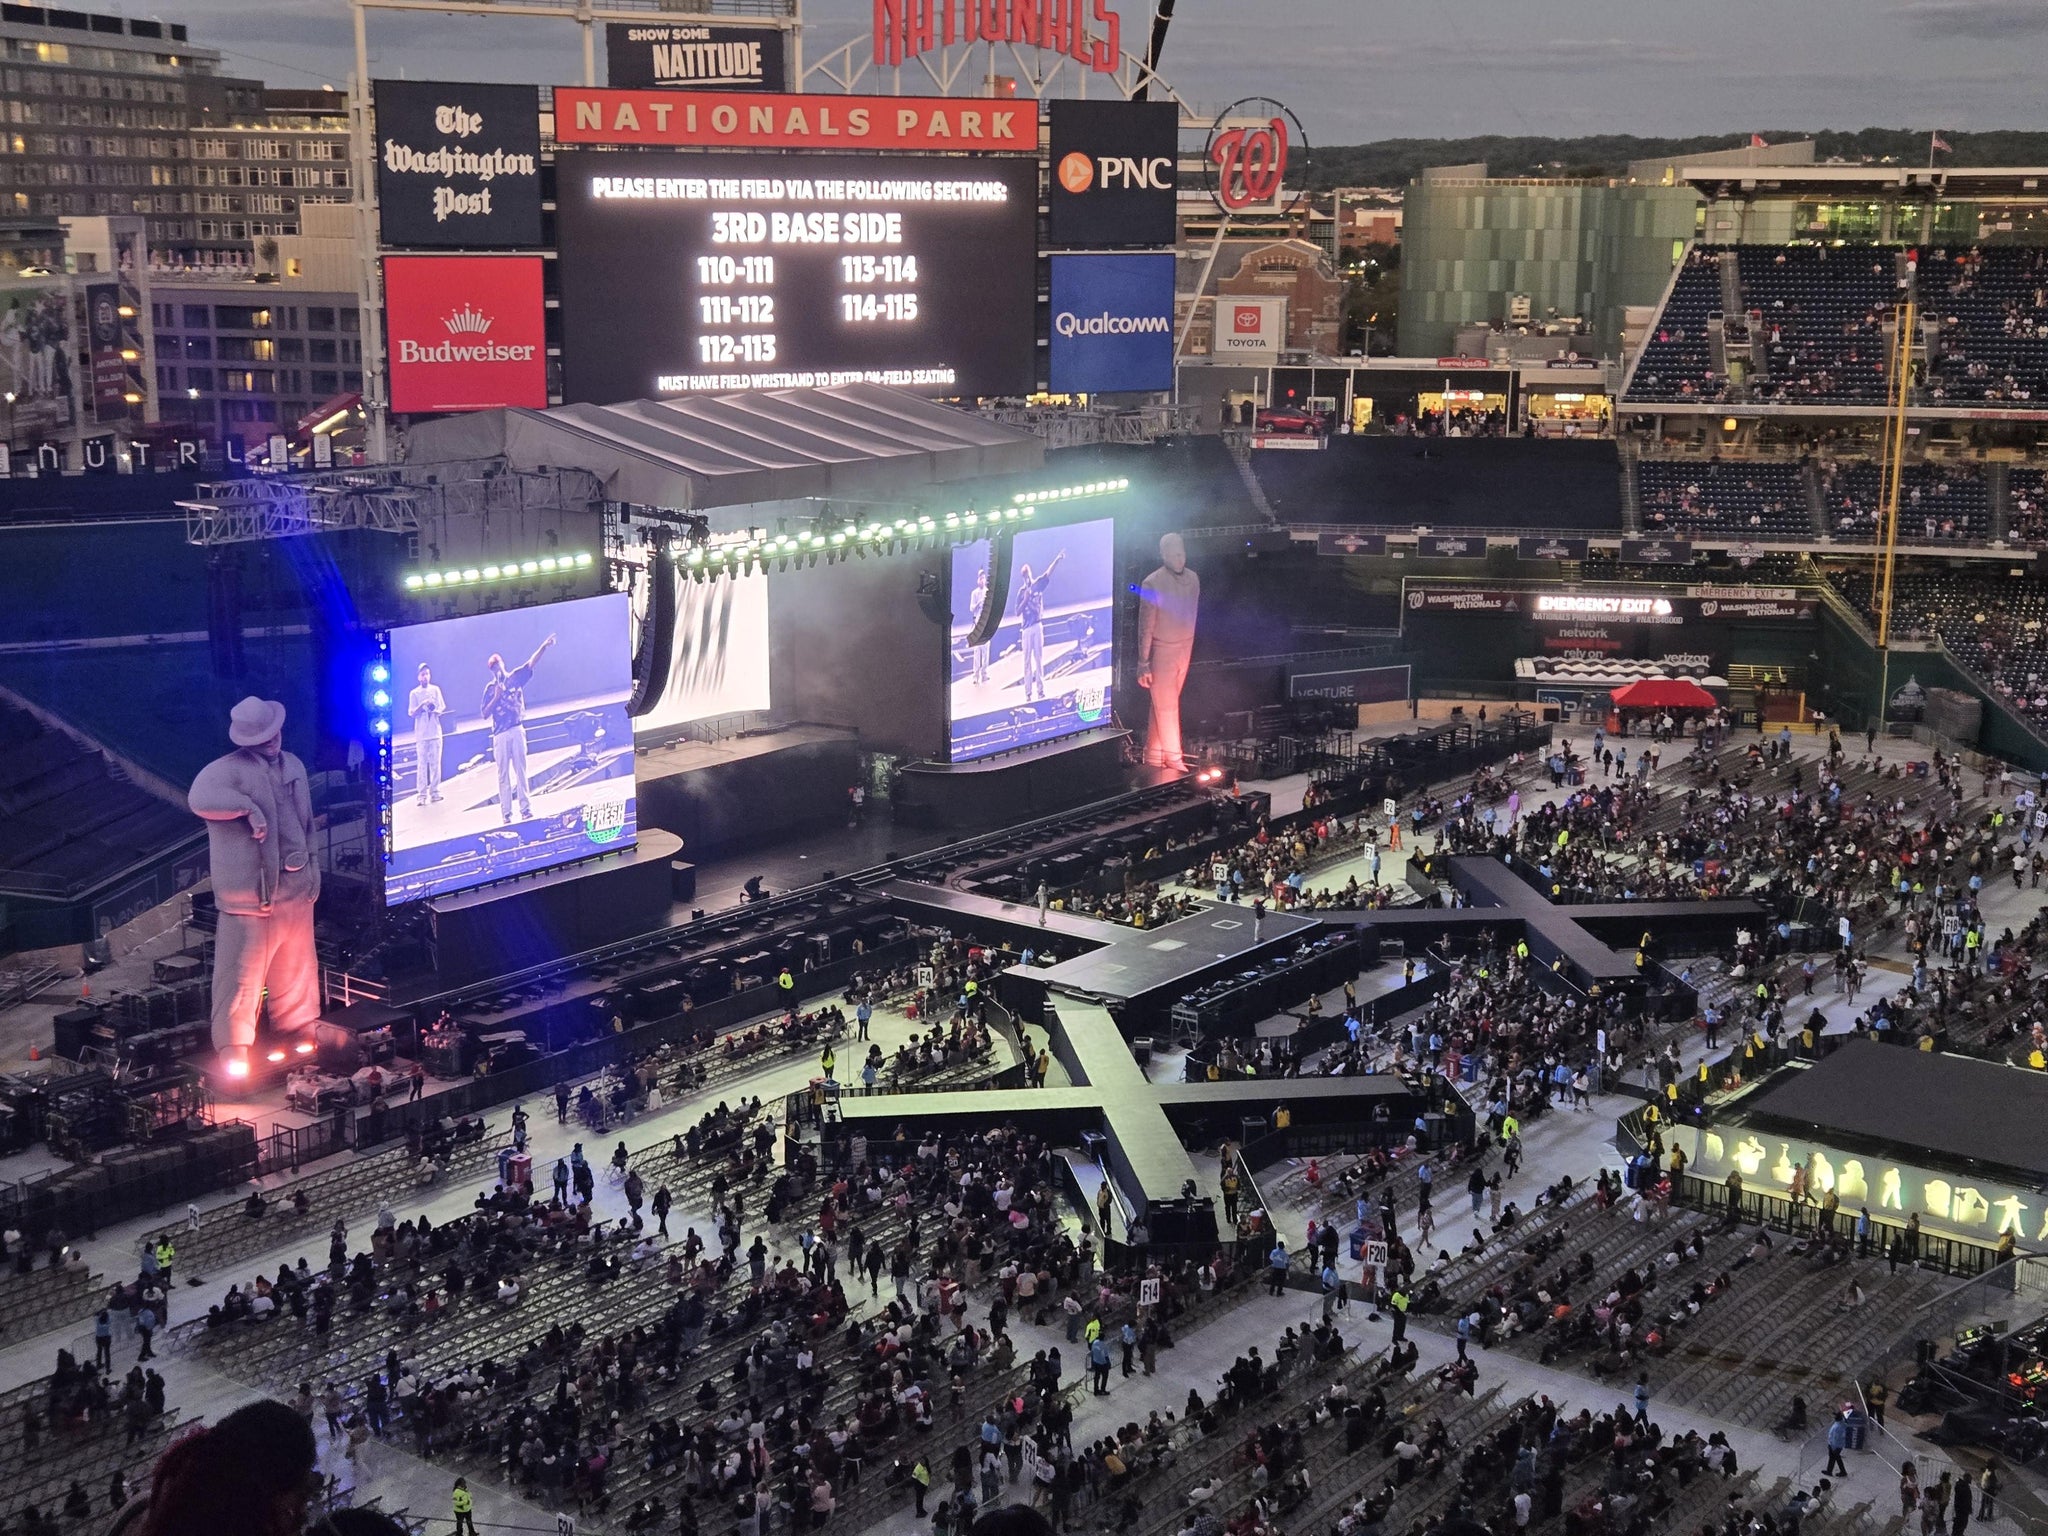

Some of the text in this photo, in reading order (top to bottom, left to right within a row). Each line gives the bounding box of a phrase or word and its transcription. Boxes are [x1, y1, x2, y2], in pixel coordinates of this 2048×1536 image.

[628, 28, 710, 41] SHOW SOME
[652, 42, 763, 78] NATITUDE
[435, 105, 483, 138] The
[575, 101, 1015, 139] NATIONALS PARK
[384, 138, 536, 182] Washington
[1098, 157, 1172, 189] PNC
[593, 177, 1008, 201] PLEASE ENTER THE FIELD VIA THE FOLLOWING SECTIONS:
[433, 186, 492, 223] Post
[712, 212, 902, 243] 3RD BASE SIDE
[698, 256, 774, 283] 110-111
[842, 255, 917, 282] 113-114
[700, 296, 774, 323] 111-112
[842, 293, 918, 321] 114-115
[1056, 311, 1169, 338] Qualcomm
[398, 340, 535, 363] Budweiser
[699, 335, 776, 362] 112-113
[1227, 339, 1267, 348] TOYOTA
[658, 375, 689, 390] MUST
[690, 375, 719, 390] HAVE
[720, 374, 750, 389] FIELD
[751, 372, 815, 388] WRISTBAND
[815, 372, 829, 386] TO
[913, 369, 955, 384] SEATING
[1436, 541, 1467, 551] CHAMPIONS
[1427, 593, 1483, 604] WASHINGTON
[1695, 588, 1775, 598] EMERGENCY EXIT
[1454, 600, 1502, 609] NATIONALS
[1538, 596, 1653, 613] EMERGENCY EXIT
[1721, 603, 1778, 611] WASHINGTON
[1747, 607, 1795, 616] NATIONALS
[1532, 612, 1571, 621] NATIONALS
[1572, 613, 1631, 623] PHILANTHROPIES
[1559, 628, 1608, 638] network
[1563, 648, 1586, 659] rely
[1664, 652, 1710, 666] verizon
[1386, 801, 1393, 812] F2
[2037, 813, 2045, 826] F9
[1366, 846, 1373, 857] F7
[1215, 867, 1225, 878] F3
[920, 971, 931, 984] F4
[1369, 1244, 1386, 1264] F20
[1143, 1283, 1158, 1302] F14
